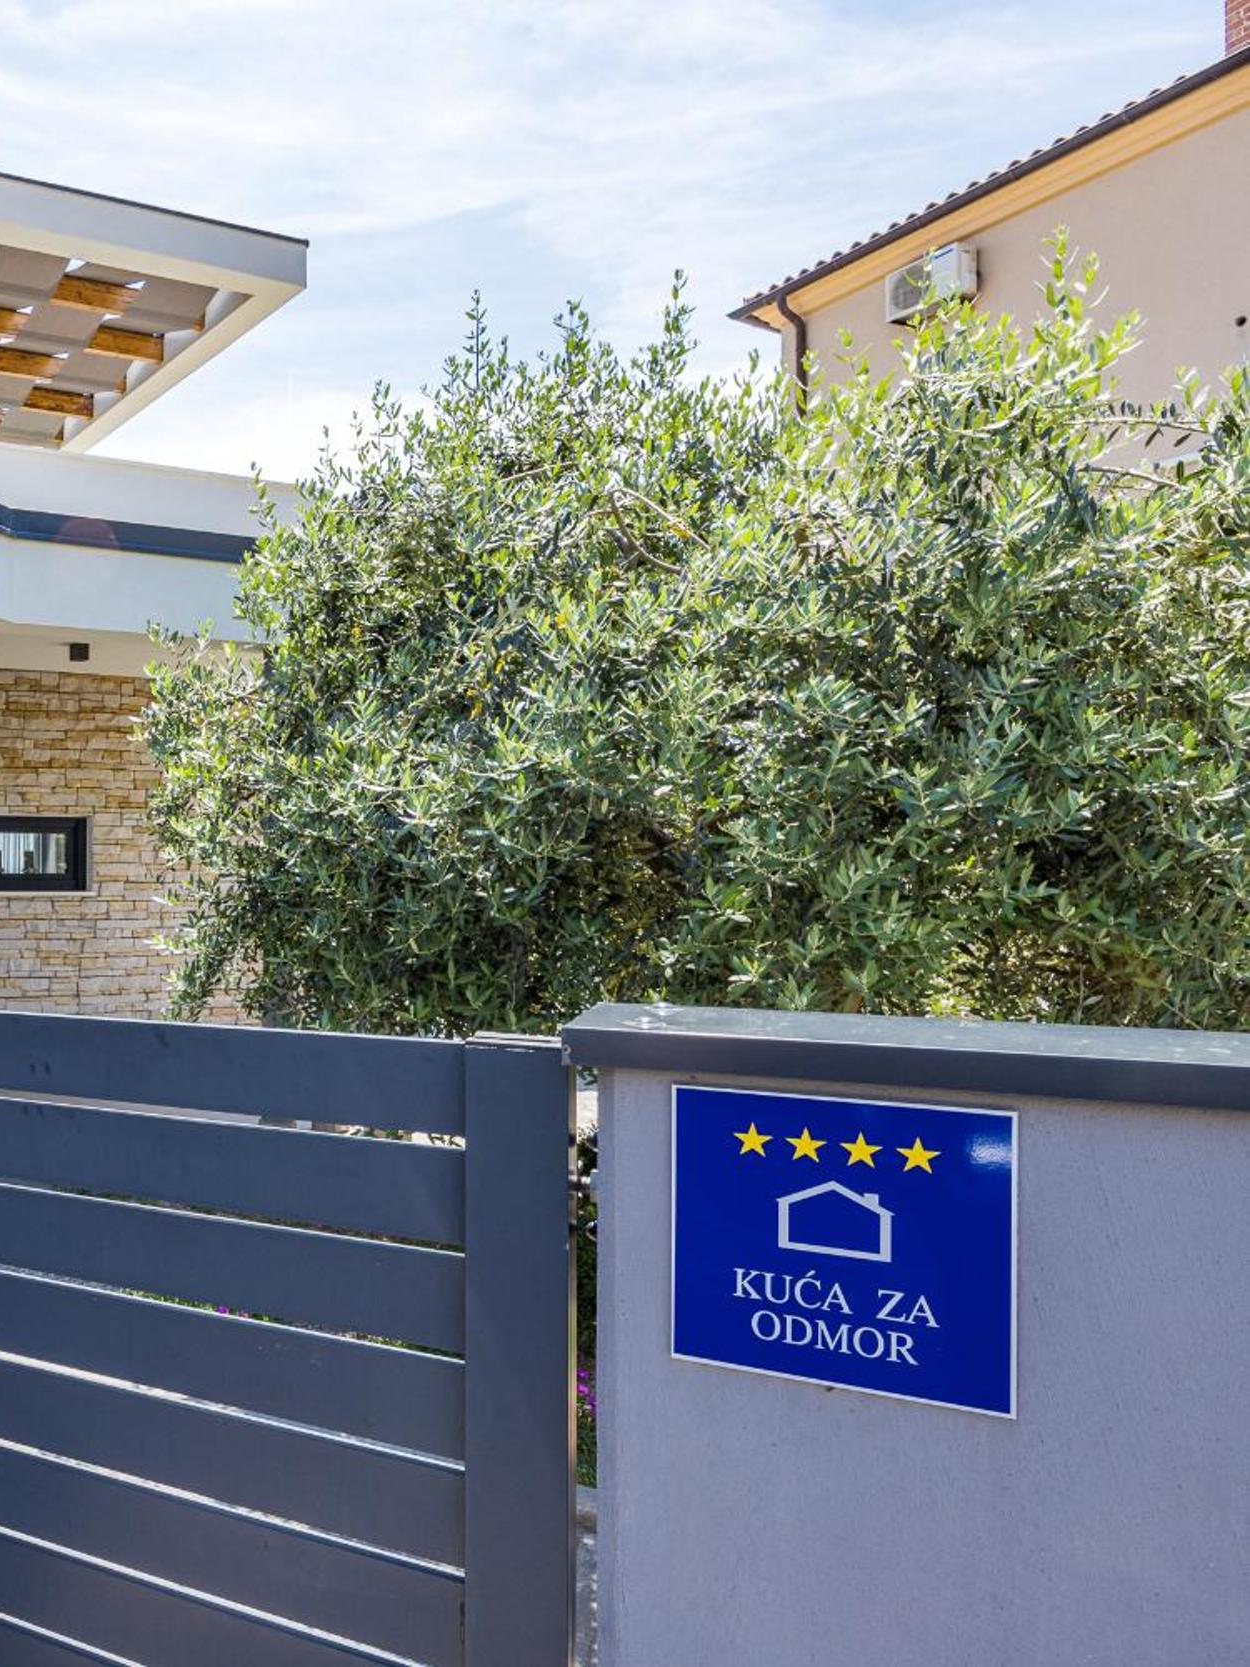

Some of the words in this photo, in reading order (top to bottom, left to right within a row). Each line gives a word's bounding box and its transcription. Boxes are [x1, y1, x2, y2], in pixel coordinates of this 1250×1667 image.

[732, 1267, 853, 1314] KUĆA
[876, 1289, 940, 1328] ZA
[750, 1310, 919, 1366] ODMOR
